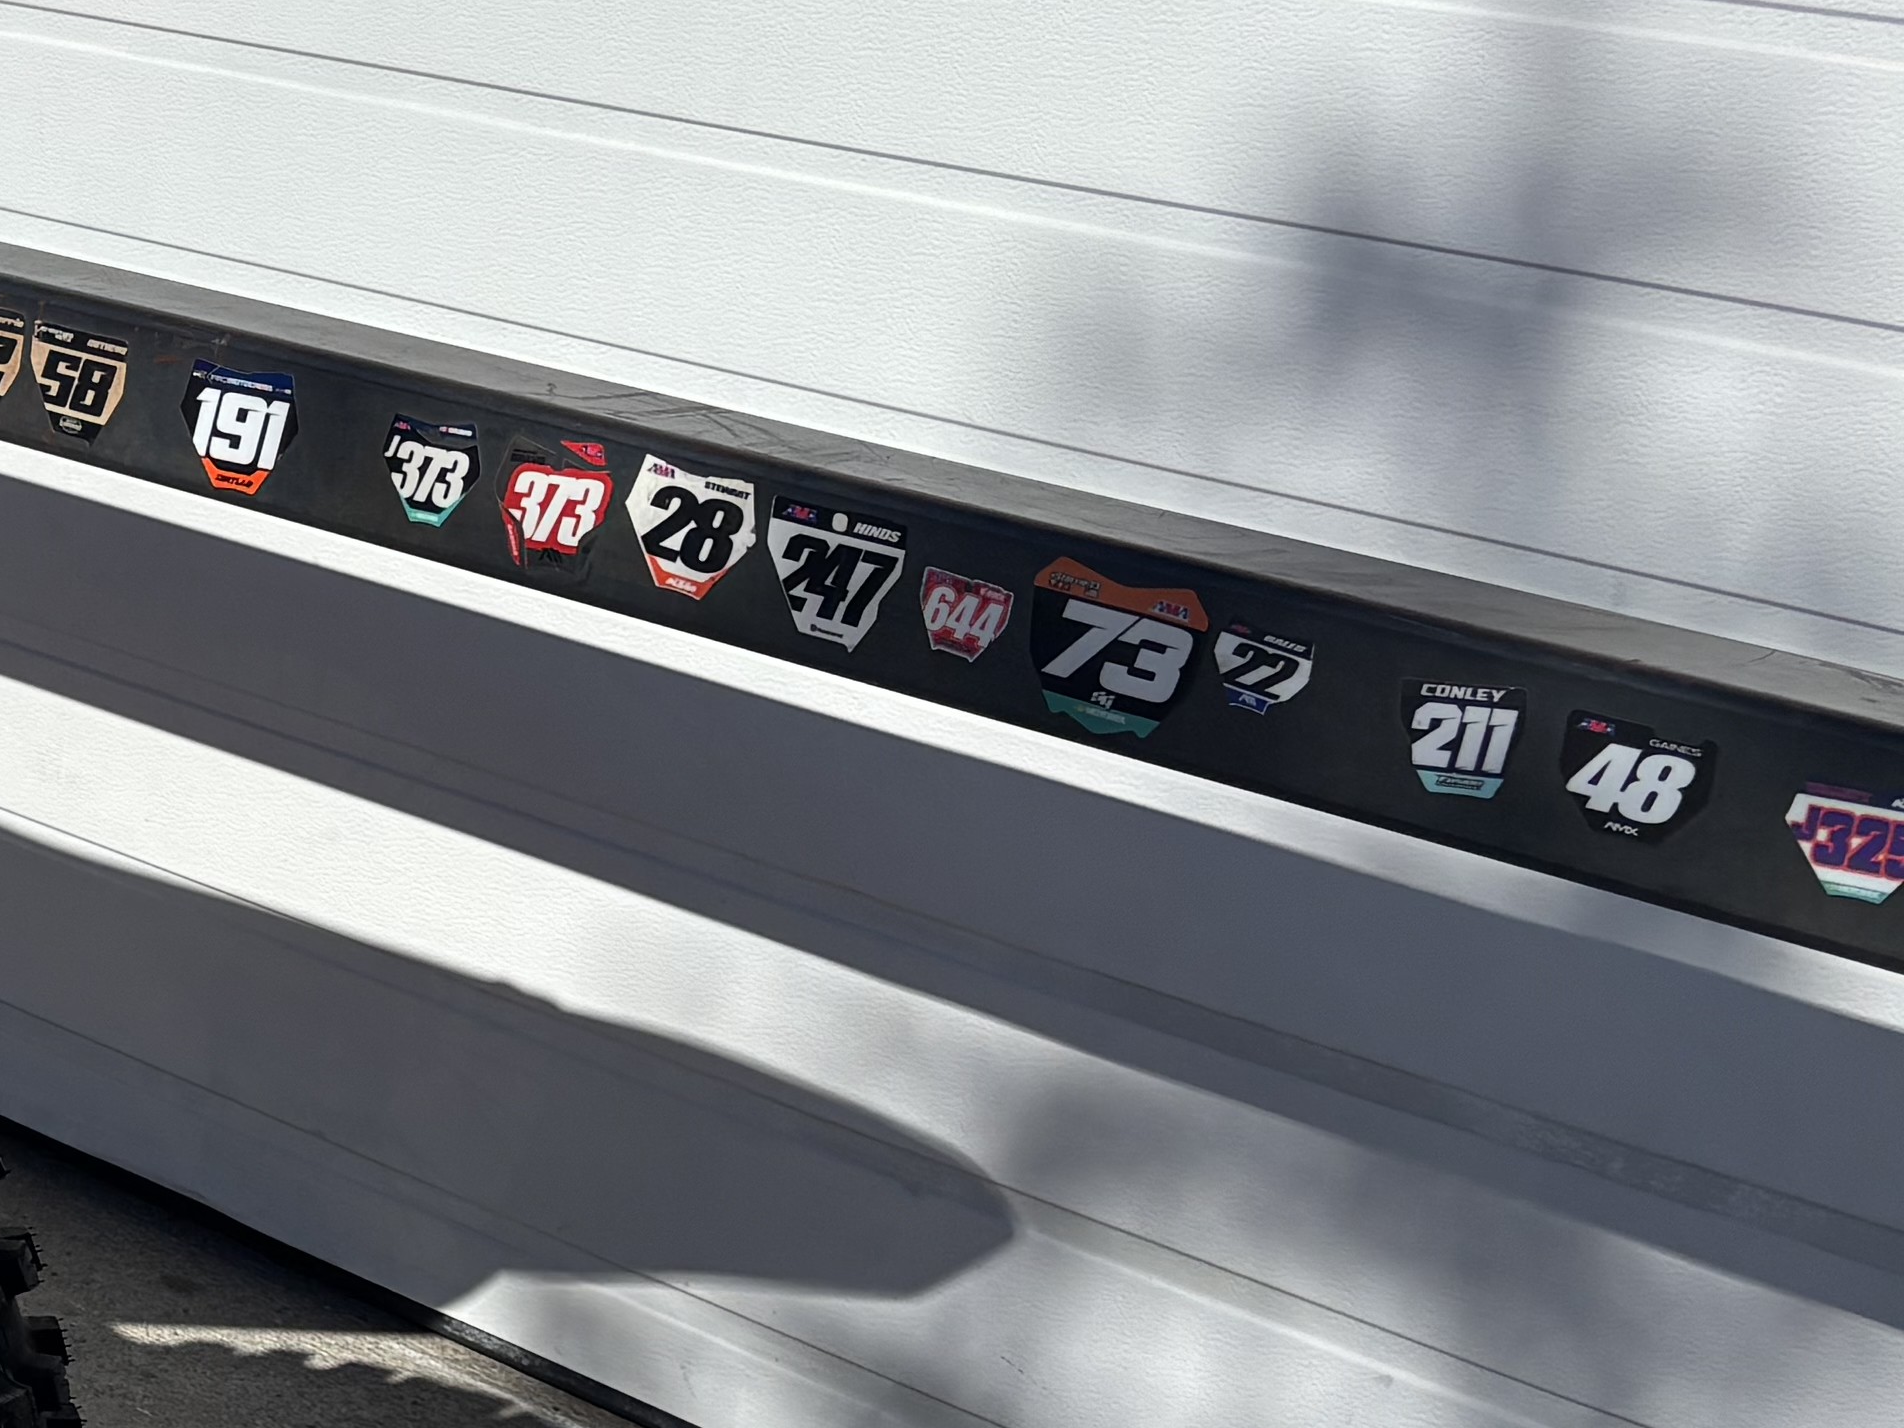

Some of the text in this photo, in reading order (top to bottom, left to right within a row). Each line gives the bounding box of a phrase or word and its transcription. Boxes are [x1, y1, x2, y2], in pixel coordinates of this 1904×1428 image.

[41, 349, 118, 418] 58
[192, 387, 291, 471] 191
[508, 471, 605, 547] 373
[641, 485, 744, 574] 28
[853, 522, 902, 543] HINDS
[781, 533, 900, 628] 247
[922, 586, 1005, 648] 644
[1041, 598, 1194, 703] 73
[1224, 642, 1300, 701] 22
[1420, 683, 1507, 703] CONLEY
[1411, 702, 1519, 774] 211
[1565, 742, 1696, 824] 48
